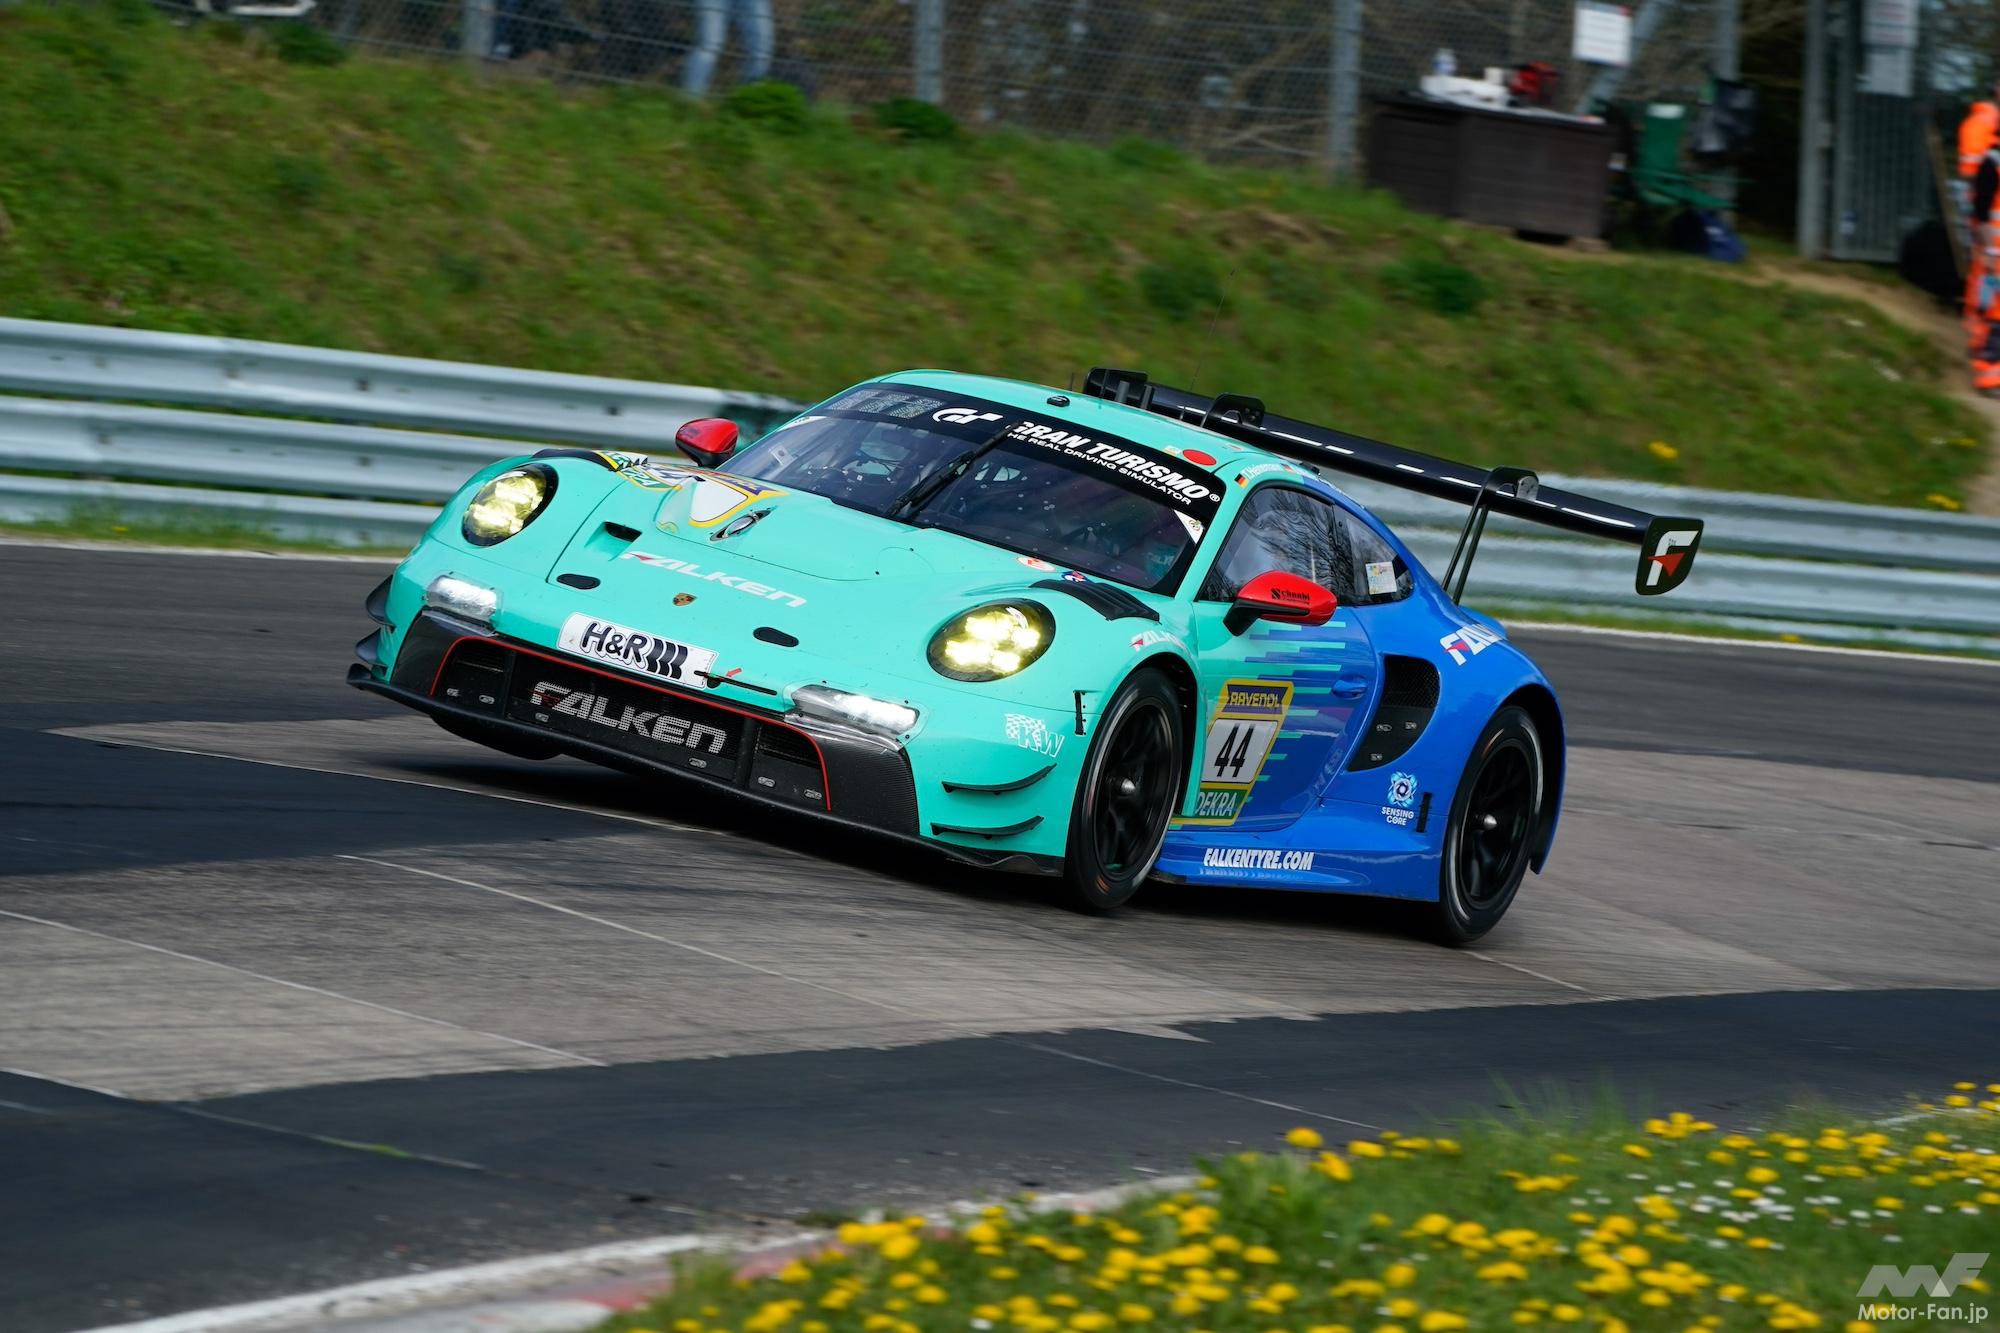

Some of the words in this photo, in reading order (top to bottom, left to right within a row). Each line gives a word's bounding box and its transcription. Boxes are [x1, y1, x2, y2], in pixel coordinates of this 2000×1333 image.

[1028, 436, 1062, 452] REAL
[1063, 447, 1117, 472] DRIVING
[1117, 466, 1193, 506] SIMULATOR
[620, 550, 808, 608] FALKEN
[581, 622, 649, 664] H&R
[528, 680, 728, 754] FALKEN
[1230, 691, 1280, 708] RAVENOL
[1214, 723, 1256, 778] 44
[1381, 806, 1415, 819] SENSING
[1386, 815, 1408, 826] CORE
[1203, 848, 1314, 871] FALKENTYRE.COM
